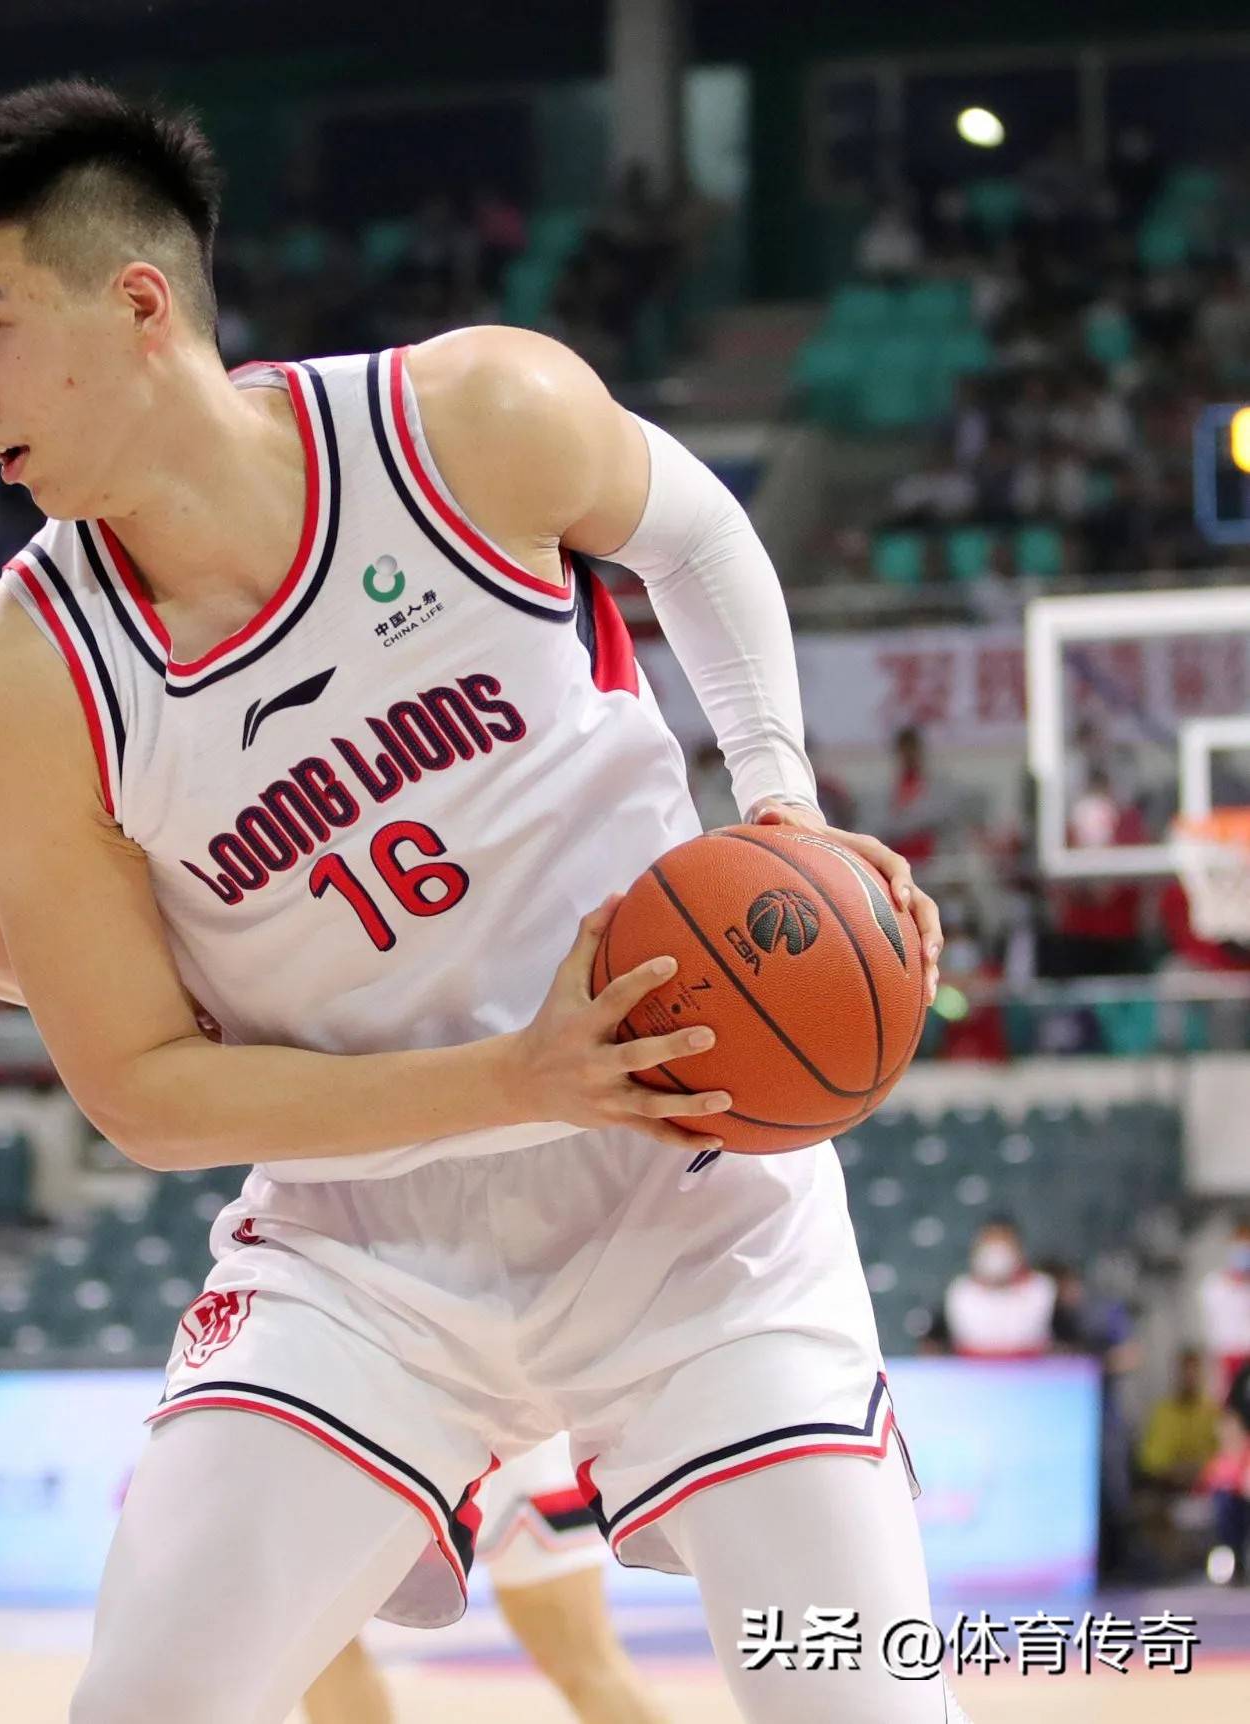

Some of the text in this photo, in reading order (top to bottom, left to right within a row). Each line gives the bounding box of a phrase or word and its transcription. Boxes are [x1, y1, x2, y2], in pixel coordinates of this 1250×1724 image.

[374, 589, 437, 637] 中国人寿
[383, 602, 444, 648] CHINA LIFE
[180, 673, 527, 906] LOONG LIONS
[309, 820, 470, 952] 16
